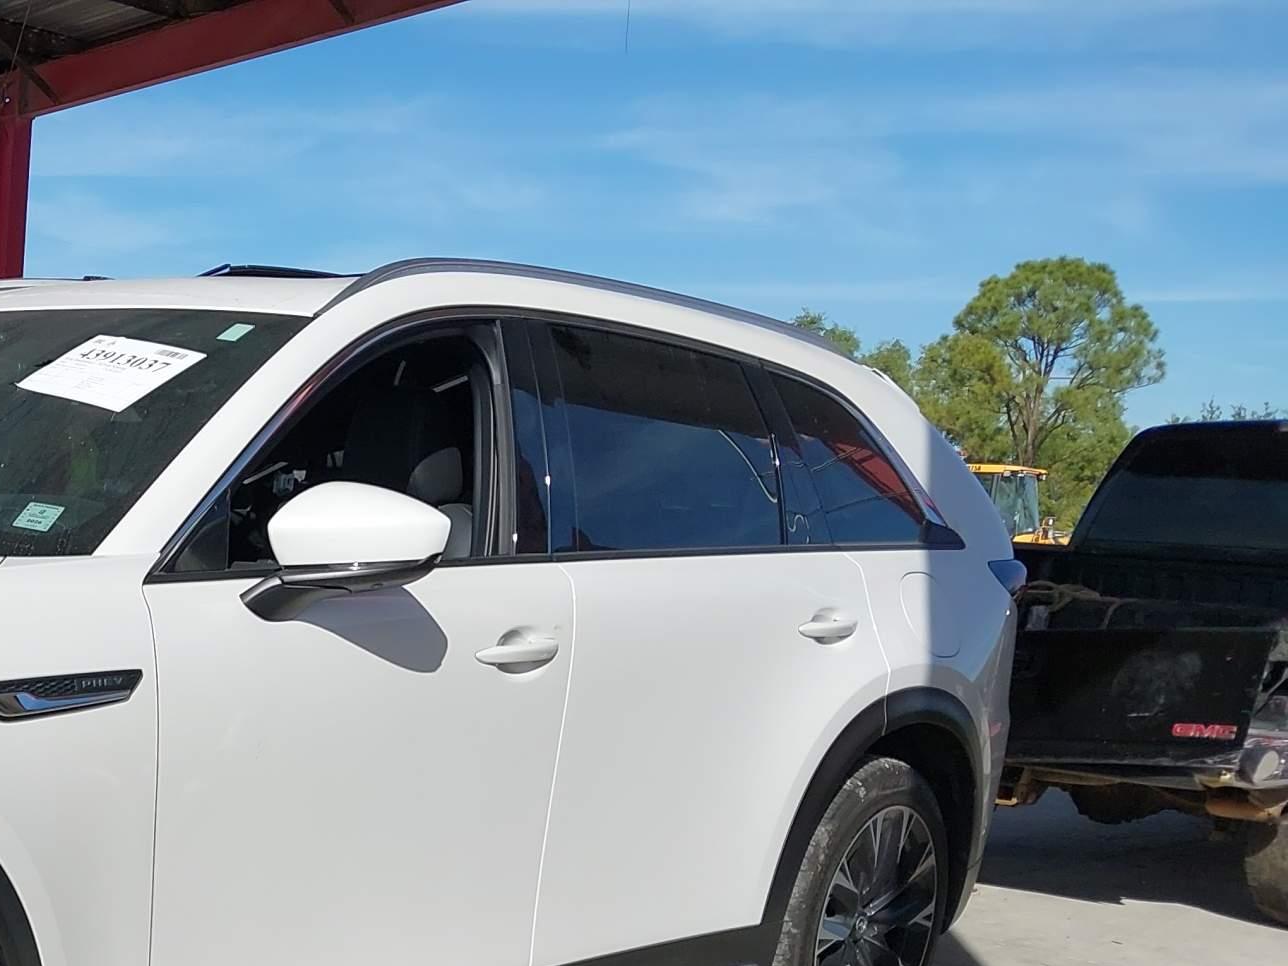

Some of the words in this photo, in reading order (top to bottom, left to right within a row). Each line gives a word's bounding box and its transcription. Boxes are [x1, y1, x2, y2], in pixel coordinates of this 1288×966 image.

[80, 347, 172, 373] 43913037
[81, 676, 123, 689] PHEV
[1172, 723, 1238, 739] GMC
